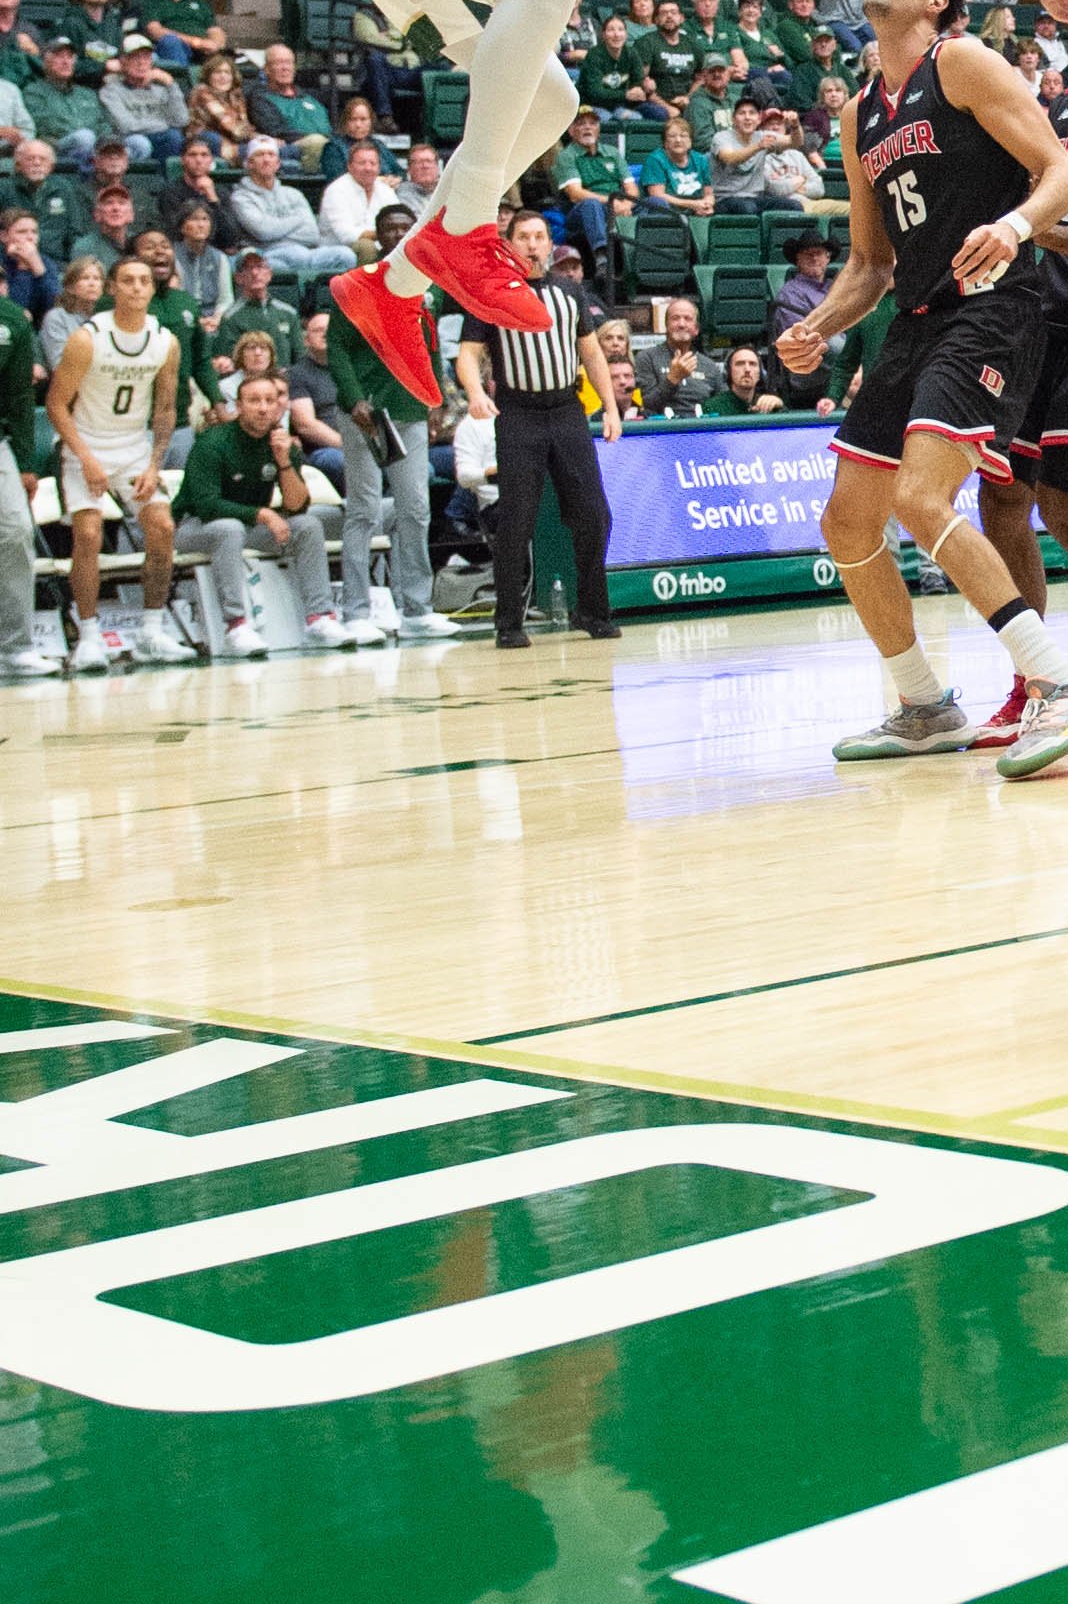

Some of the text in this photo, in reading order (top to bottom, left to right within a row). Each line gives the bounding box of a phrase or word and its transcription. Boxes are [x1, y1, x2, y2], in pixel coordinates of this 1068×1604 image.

[861, 119, 943, 189] DENVER
[886, 169, 927, 233] 15
[113, 384, 134, 415] 0
[675, 452, 837, 489] Limited availa
[687, 499, 778, 530] Service
[781, 496, 807, 523] in
[679, 572, 726, 596] fnbo
